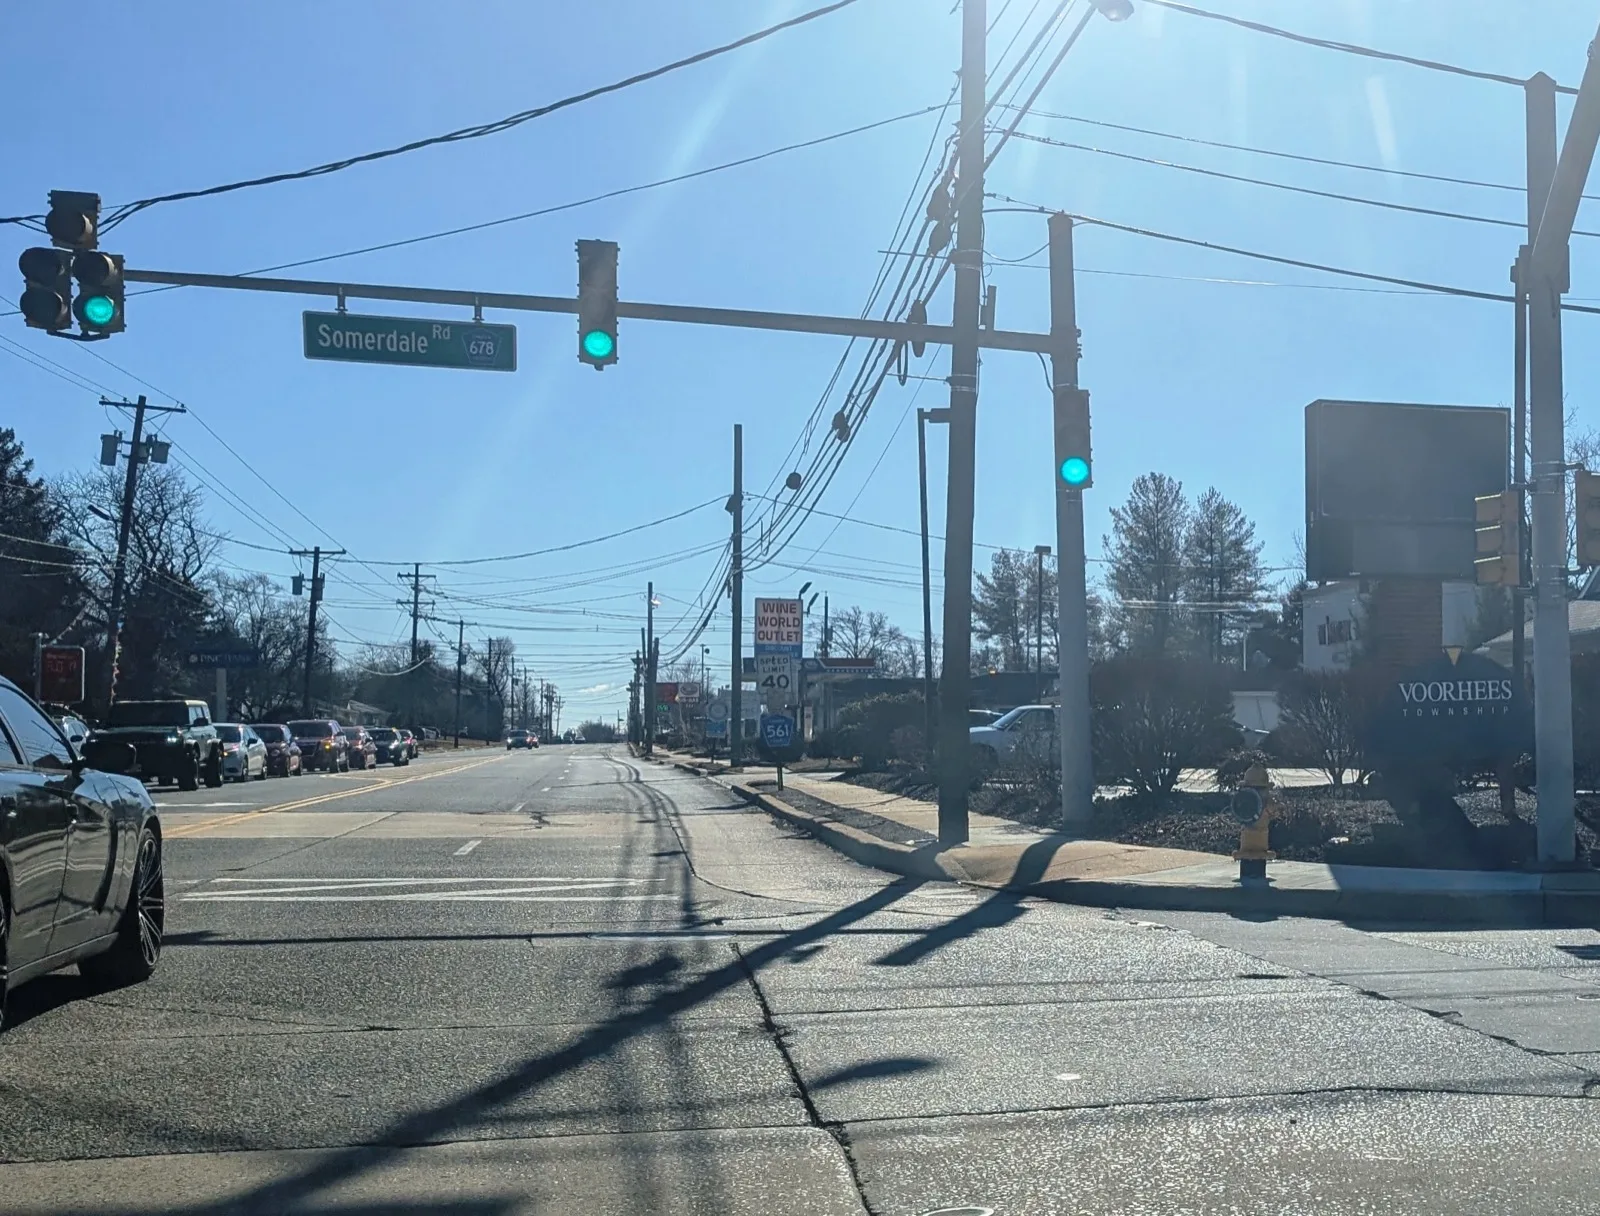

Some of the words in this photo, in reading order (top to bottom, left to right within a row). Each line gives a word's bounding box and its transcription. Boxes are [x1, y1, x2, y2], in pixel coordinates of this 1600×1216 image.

[318, 324, 429, 354] Somerdale
[432, 324, 451, 340] Rd
[469, 341, 494, 355] 678
[762, 602, 797, 614] WINE
[758, 616, 801, 628] WORLD
[758, 630, 800, 642] OUTLET
[760, 656, 789, 665] SPEED
[761, 674, 790, 689] 40
[1398, 680, 1513, 702] VOORHEES
[1403, 706, 1508, 716] TOWNSHIP
[767, 724, 789, 738] 561
